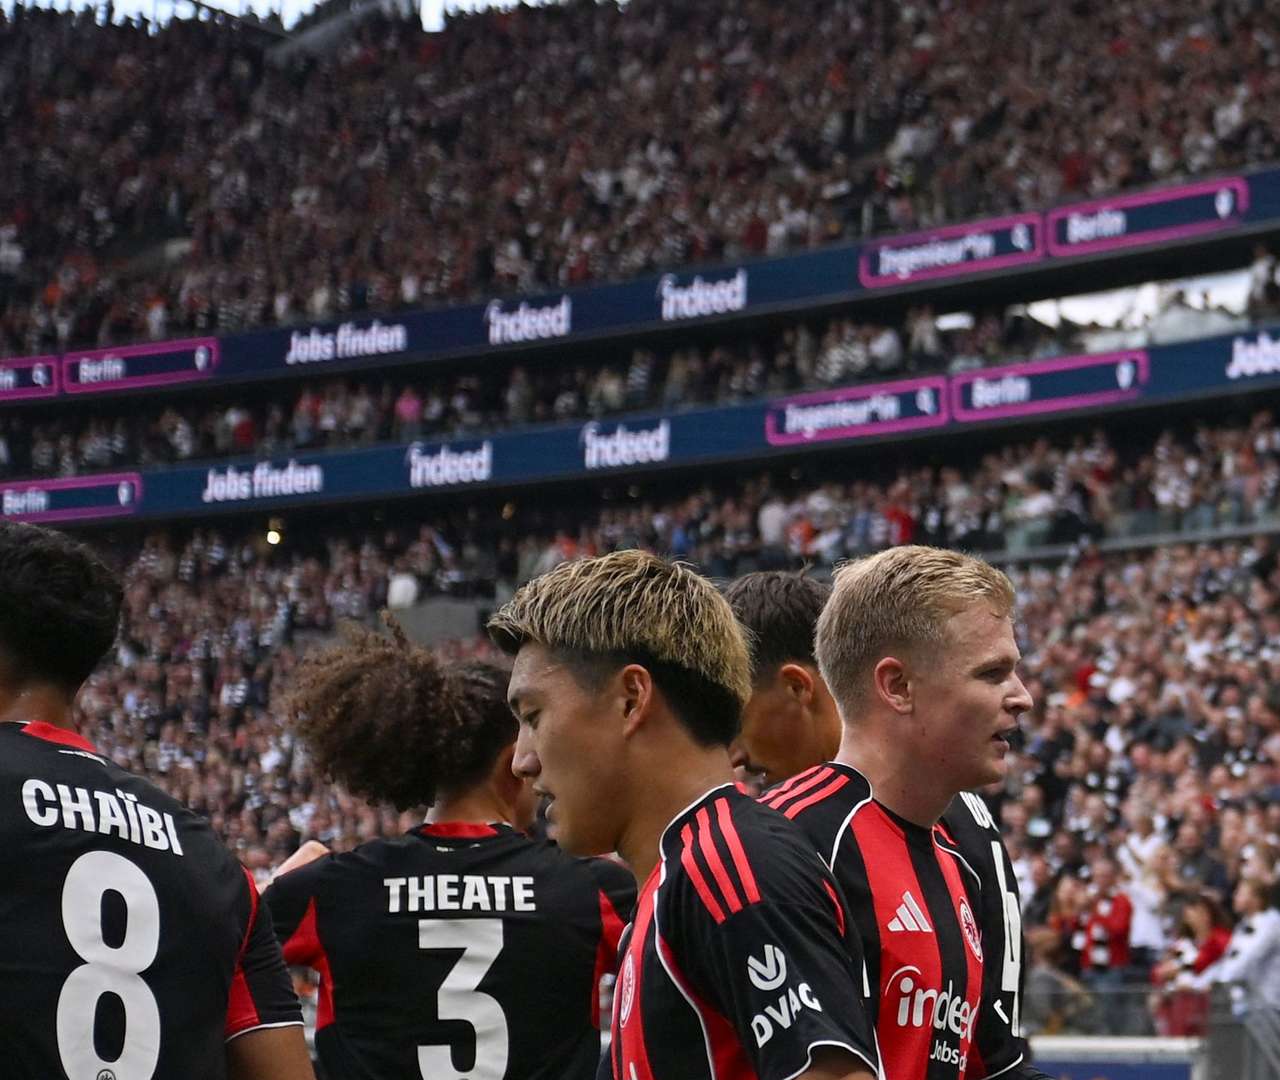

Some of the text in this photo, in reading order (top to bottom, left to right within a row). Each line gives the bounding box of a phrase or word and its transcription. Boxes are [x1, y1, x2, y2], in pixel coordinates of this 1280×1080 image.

[659, 268, 747, 321] indeed
[286, 321, 407, 365] Jobs finden
[486, 296, 571, 345] indeed
[407, 440, 493, 488] indeed
[581, 419, 670, 470] indeed
[202, 458, 323, 503] Jobs finden
[22, 779, 183, 857] CHAÏBI
[384, 875, 536, 912] THEATE
[751, 983, 823, 1049] DVAG
